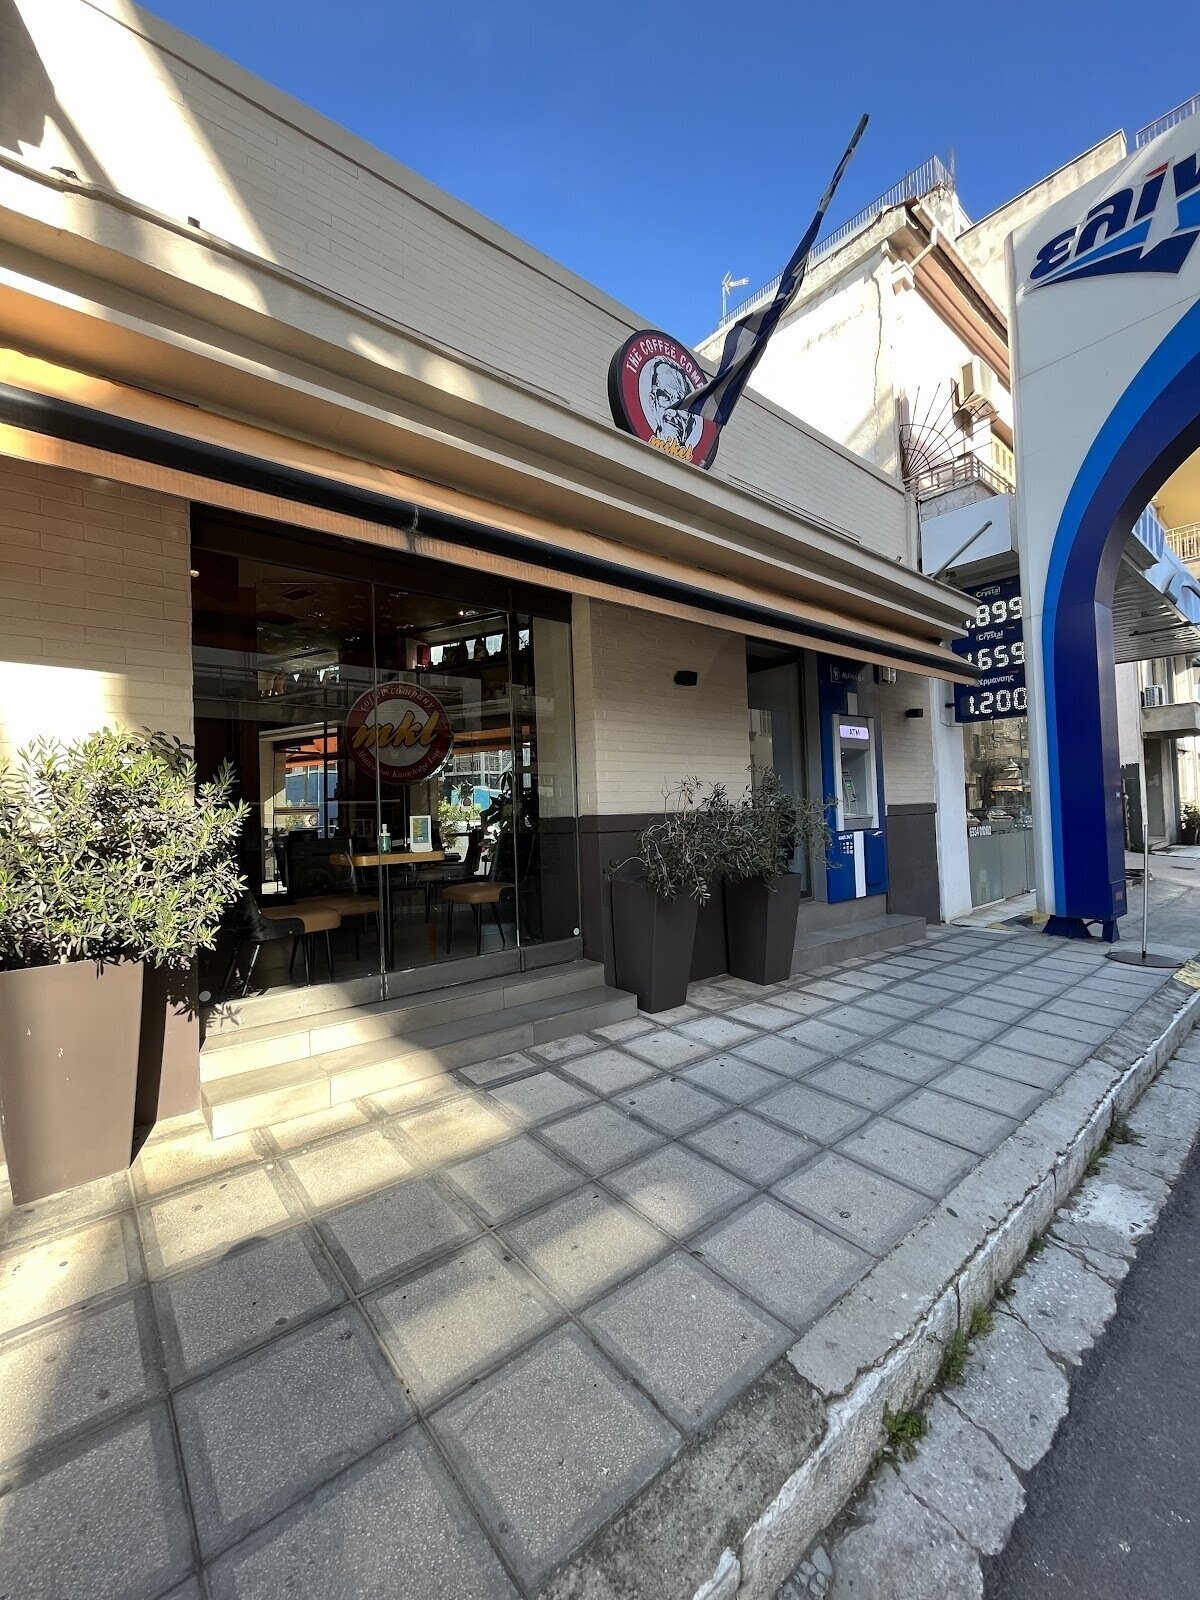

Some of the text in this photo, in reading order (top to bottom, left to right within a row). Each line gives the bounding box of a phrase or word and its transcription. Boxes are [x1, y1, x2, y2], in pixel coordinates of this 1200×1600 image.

[626, 347, 642, 373] THE
[640, 339, 676, 359] COFFEE
[976, 586, 1001, 598] Crystal
[978, 630, 1003, 641] Crystal
[969, 687, 1027, 714] 1.200
[351, 710, 440, 748] mkl
[849, 728, 860, 737] ATM
